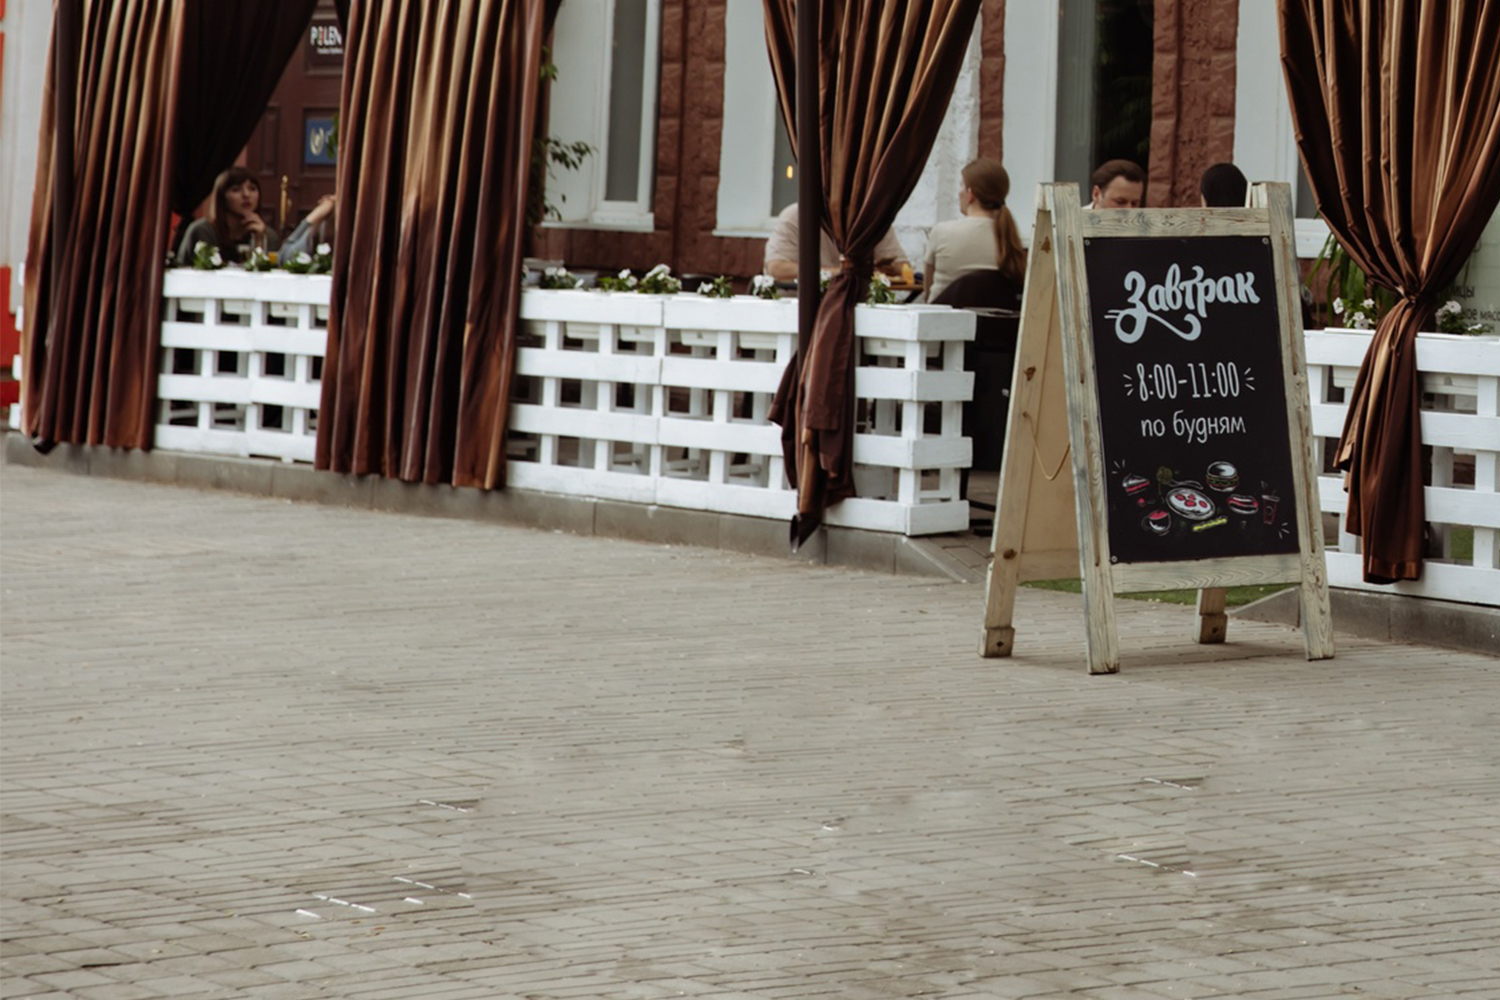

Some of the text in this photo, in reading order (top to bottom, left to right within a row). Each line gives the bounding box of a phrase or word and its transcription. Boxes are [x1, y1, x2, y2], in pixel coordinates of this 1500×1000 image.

[1104, 263, 1261, 343] Завтрак
[1136, 362, 1240, 401] 8:00-11:00
[1141, 410, 1246, 443] по будням
